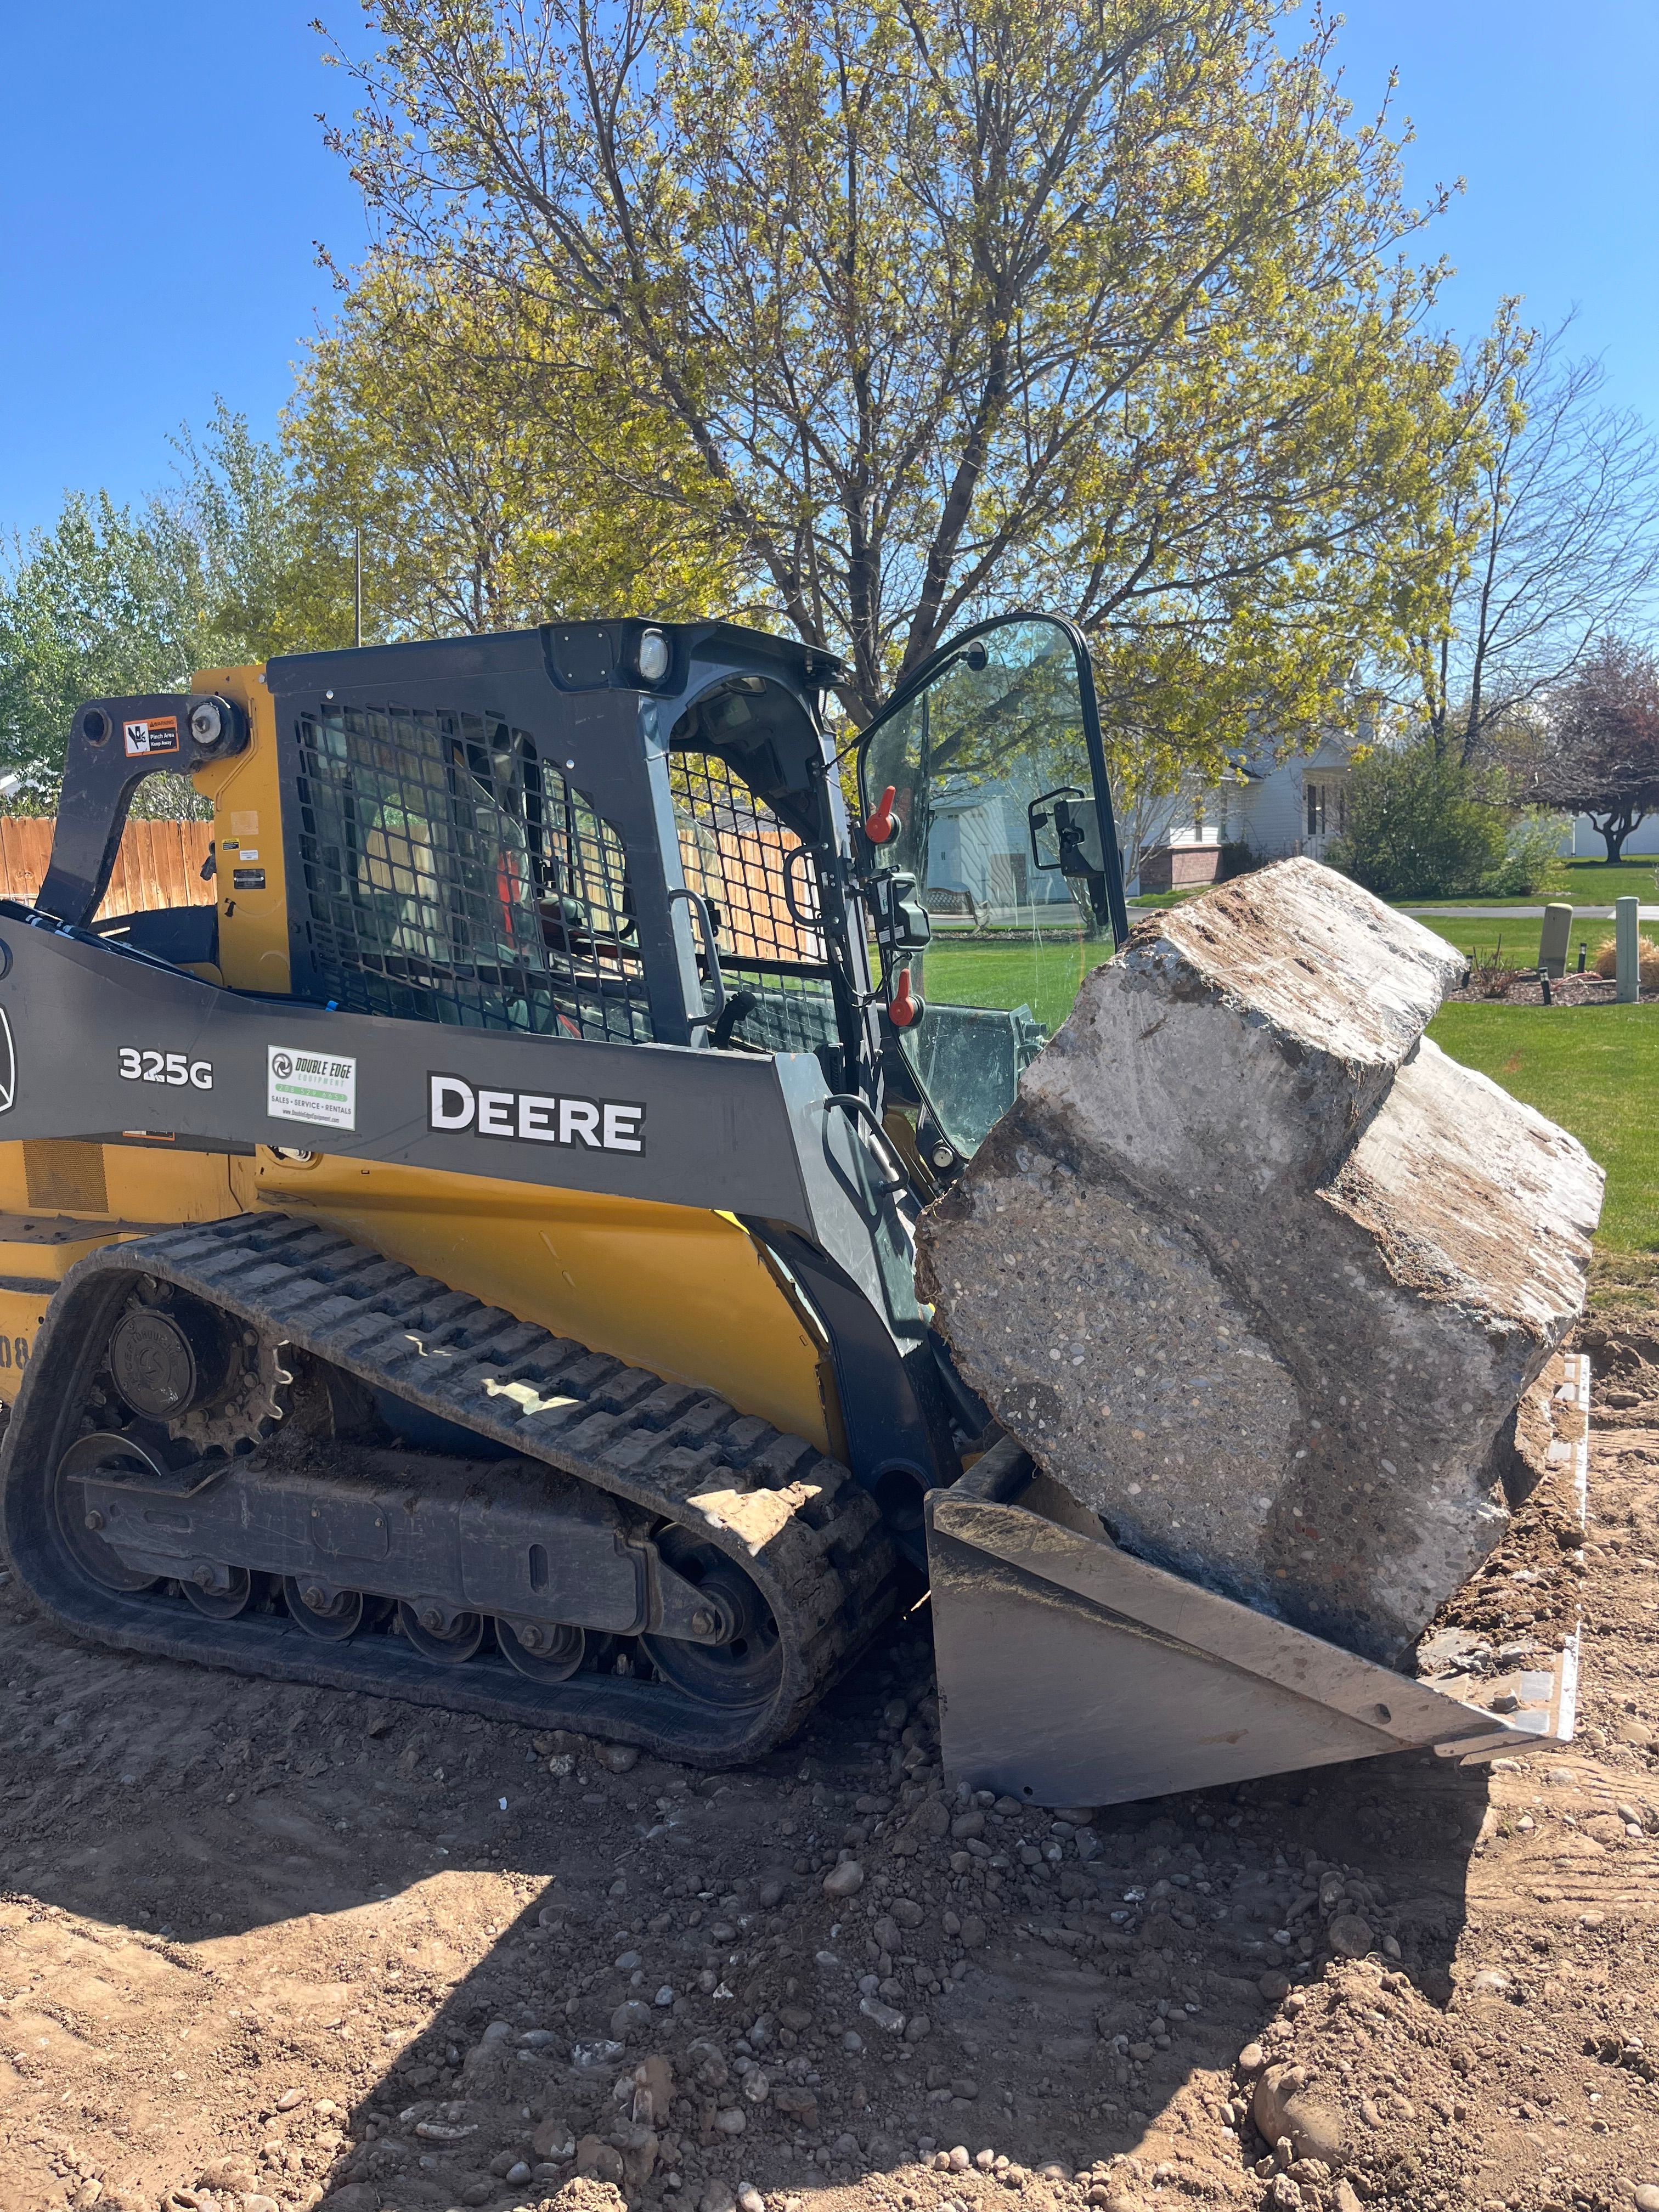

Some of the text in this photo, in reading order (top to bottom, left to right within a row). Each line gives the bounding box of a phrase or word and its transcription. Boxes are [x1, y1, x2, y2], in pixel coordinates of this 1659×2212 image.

[120, 1048, 212, 1089] 325G
[295, 1058, 352, 1079] DOUBLE EDGE
[298, 1074, 345, 1087] EQUIPMENT
[272, 1096, 352, 1114] SALES SERVICE RENTALS
[322, 1092, 345, 1101] 6653
[283, 1109, 340, 1123] www.DoubleEdgeEquipment.com
[432, 1076, 641, 1152] DEERE
